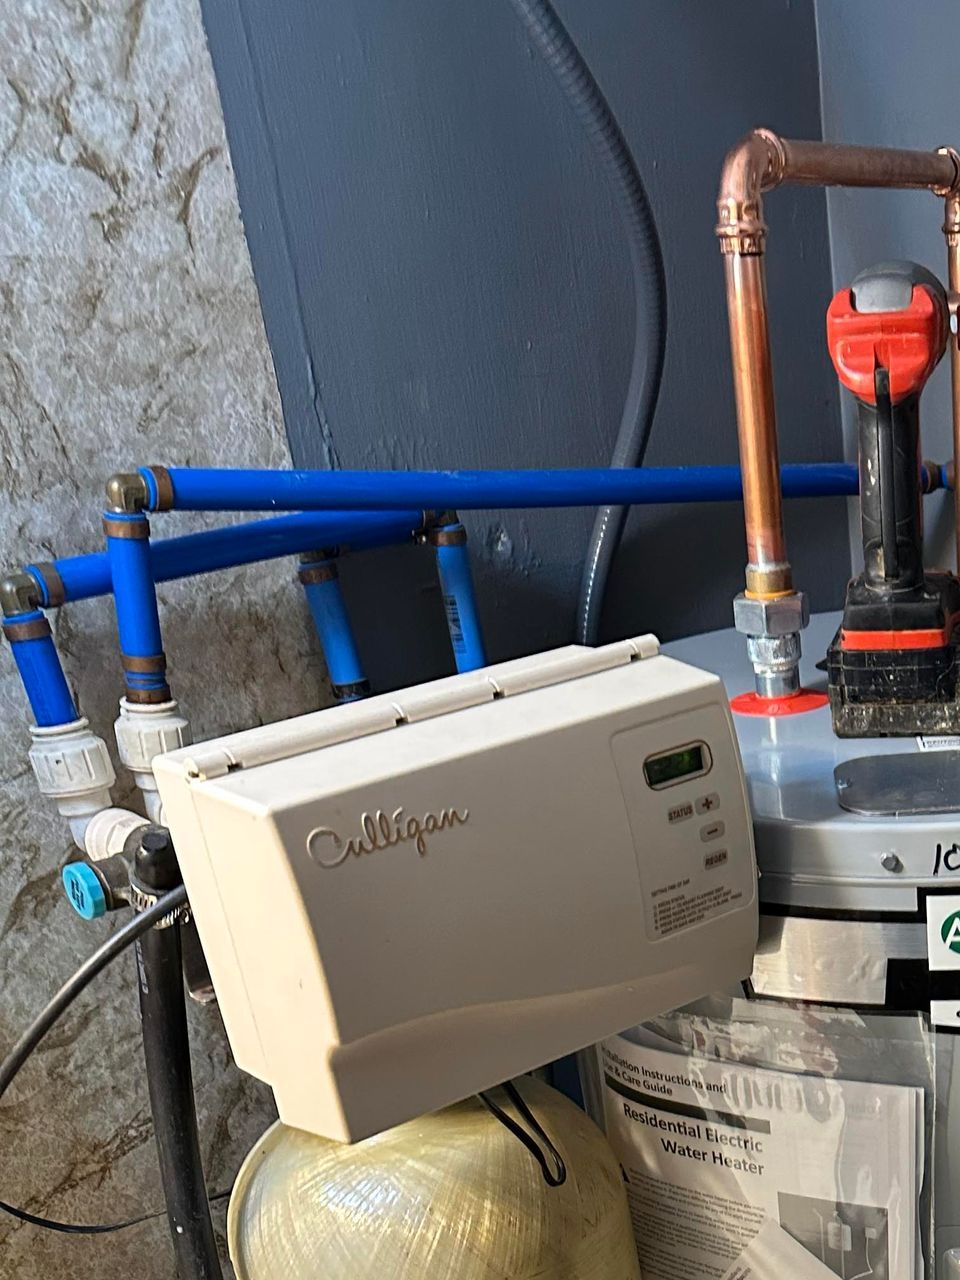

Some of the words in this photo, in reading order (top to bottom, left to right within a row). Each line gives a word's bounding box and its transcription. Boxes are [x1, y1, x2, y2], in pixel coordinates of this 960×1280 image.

[668, 804, 694, 821] STATUS
[306, 806, 469, 868] Culligan
[704, 852, 728, 867] REGEN
[622, 1071, 641, 1087] Care
[643, 1080, 673, 1096] Guide
[641, 1066, 704, 1090] Instructions
[706, 1081, 727, 1093] and
[623, 1103, 701, 1139] Residential
[706, 1128, 763, 1153] Electric
[660, 1138, 708, 1162] Water
[712, 1151, 765, 1176] Heater
